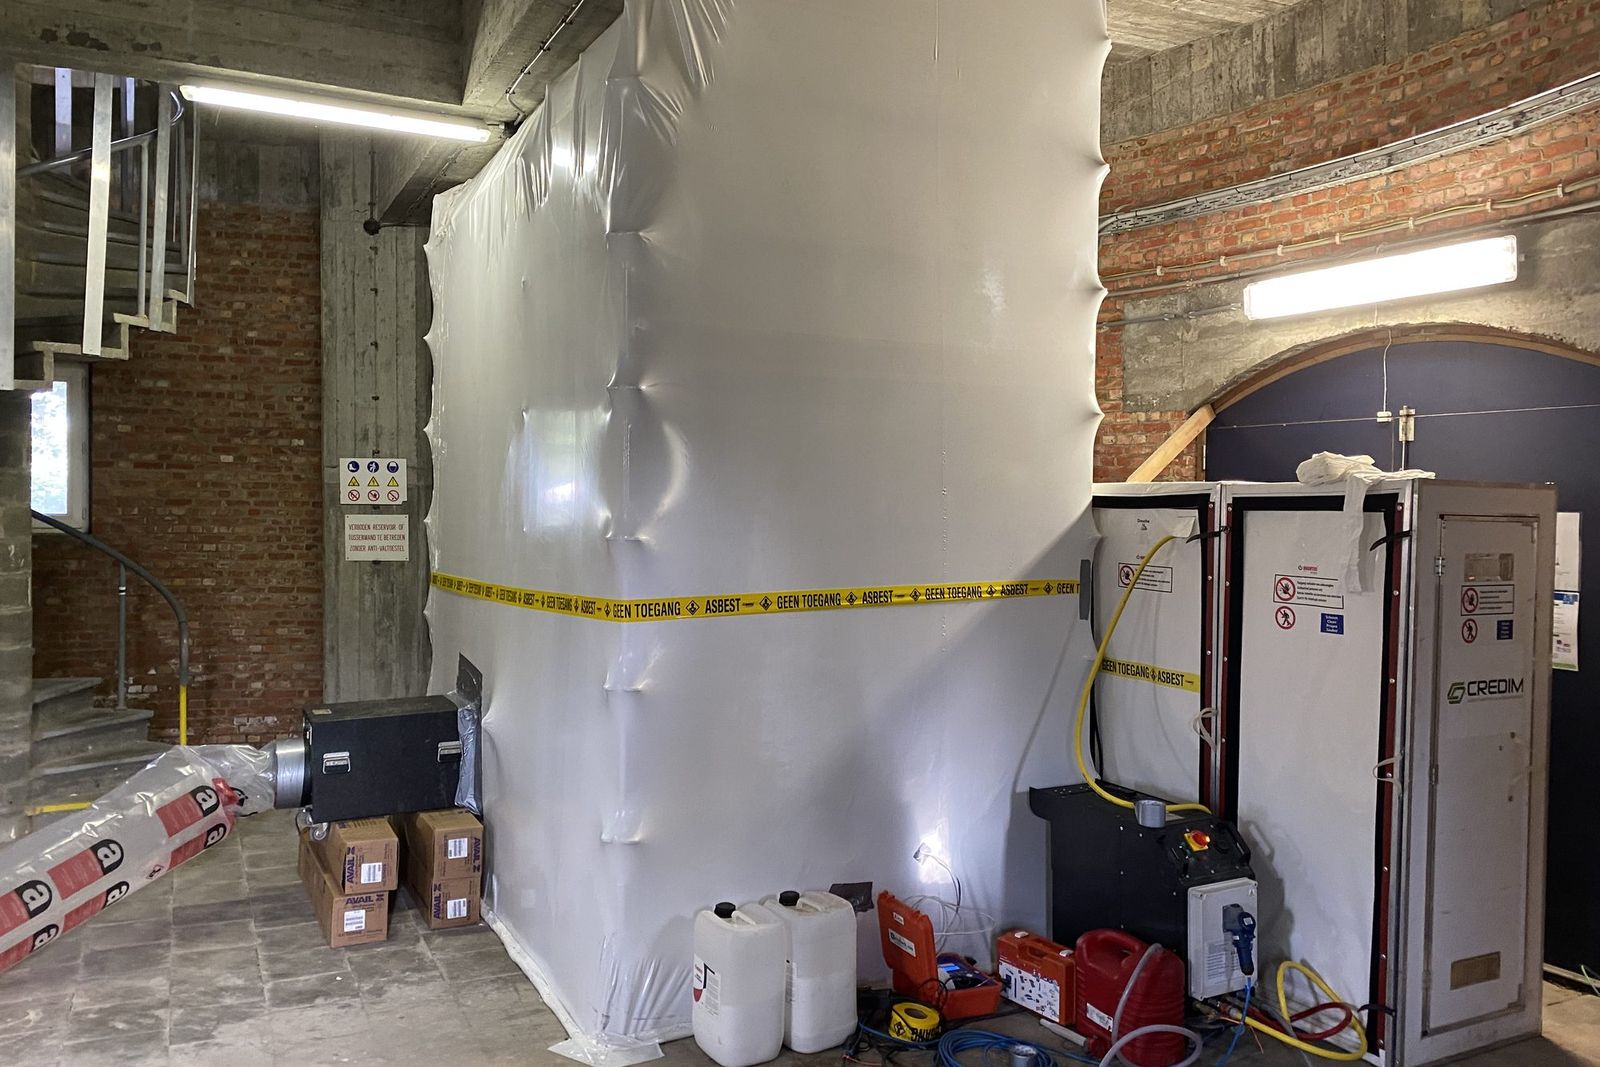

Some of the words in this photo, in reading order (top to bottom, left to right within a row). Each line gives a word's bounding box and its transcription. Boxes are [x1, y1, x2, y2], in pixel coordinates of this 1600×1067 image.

[581, 600, 596, 615] ASBEST
[613, 603, 631, 618] GEEN
[634, 601, 680, 617] TOEGANG
[705, 598, 741, 614] ASBEST
[777, 595, 799, 609] GEEN
[802, 593, 841, 607] TOEGANG
[862, 590, 893, 604] ASBEST
[925, 587, 945, 600] GEEN
[947, 586, 982, 599] TOEGANG
[1000, 583, 1028, 596] ASBEST
[1056, 583, 1074, 594] GEEN
[1117, 662, 1149, 679] TOEGANG
[1157, 671, 1184, 686] ASBEST
[1467, 678, 1524, 696] CREDIM
[473, 837, 481, 863] AVAIL
[346, 856, 355, 884] AVAIL
[346, 896, 374, 905] AVAIL
[433, 893, 442, 919] AVAIL
